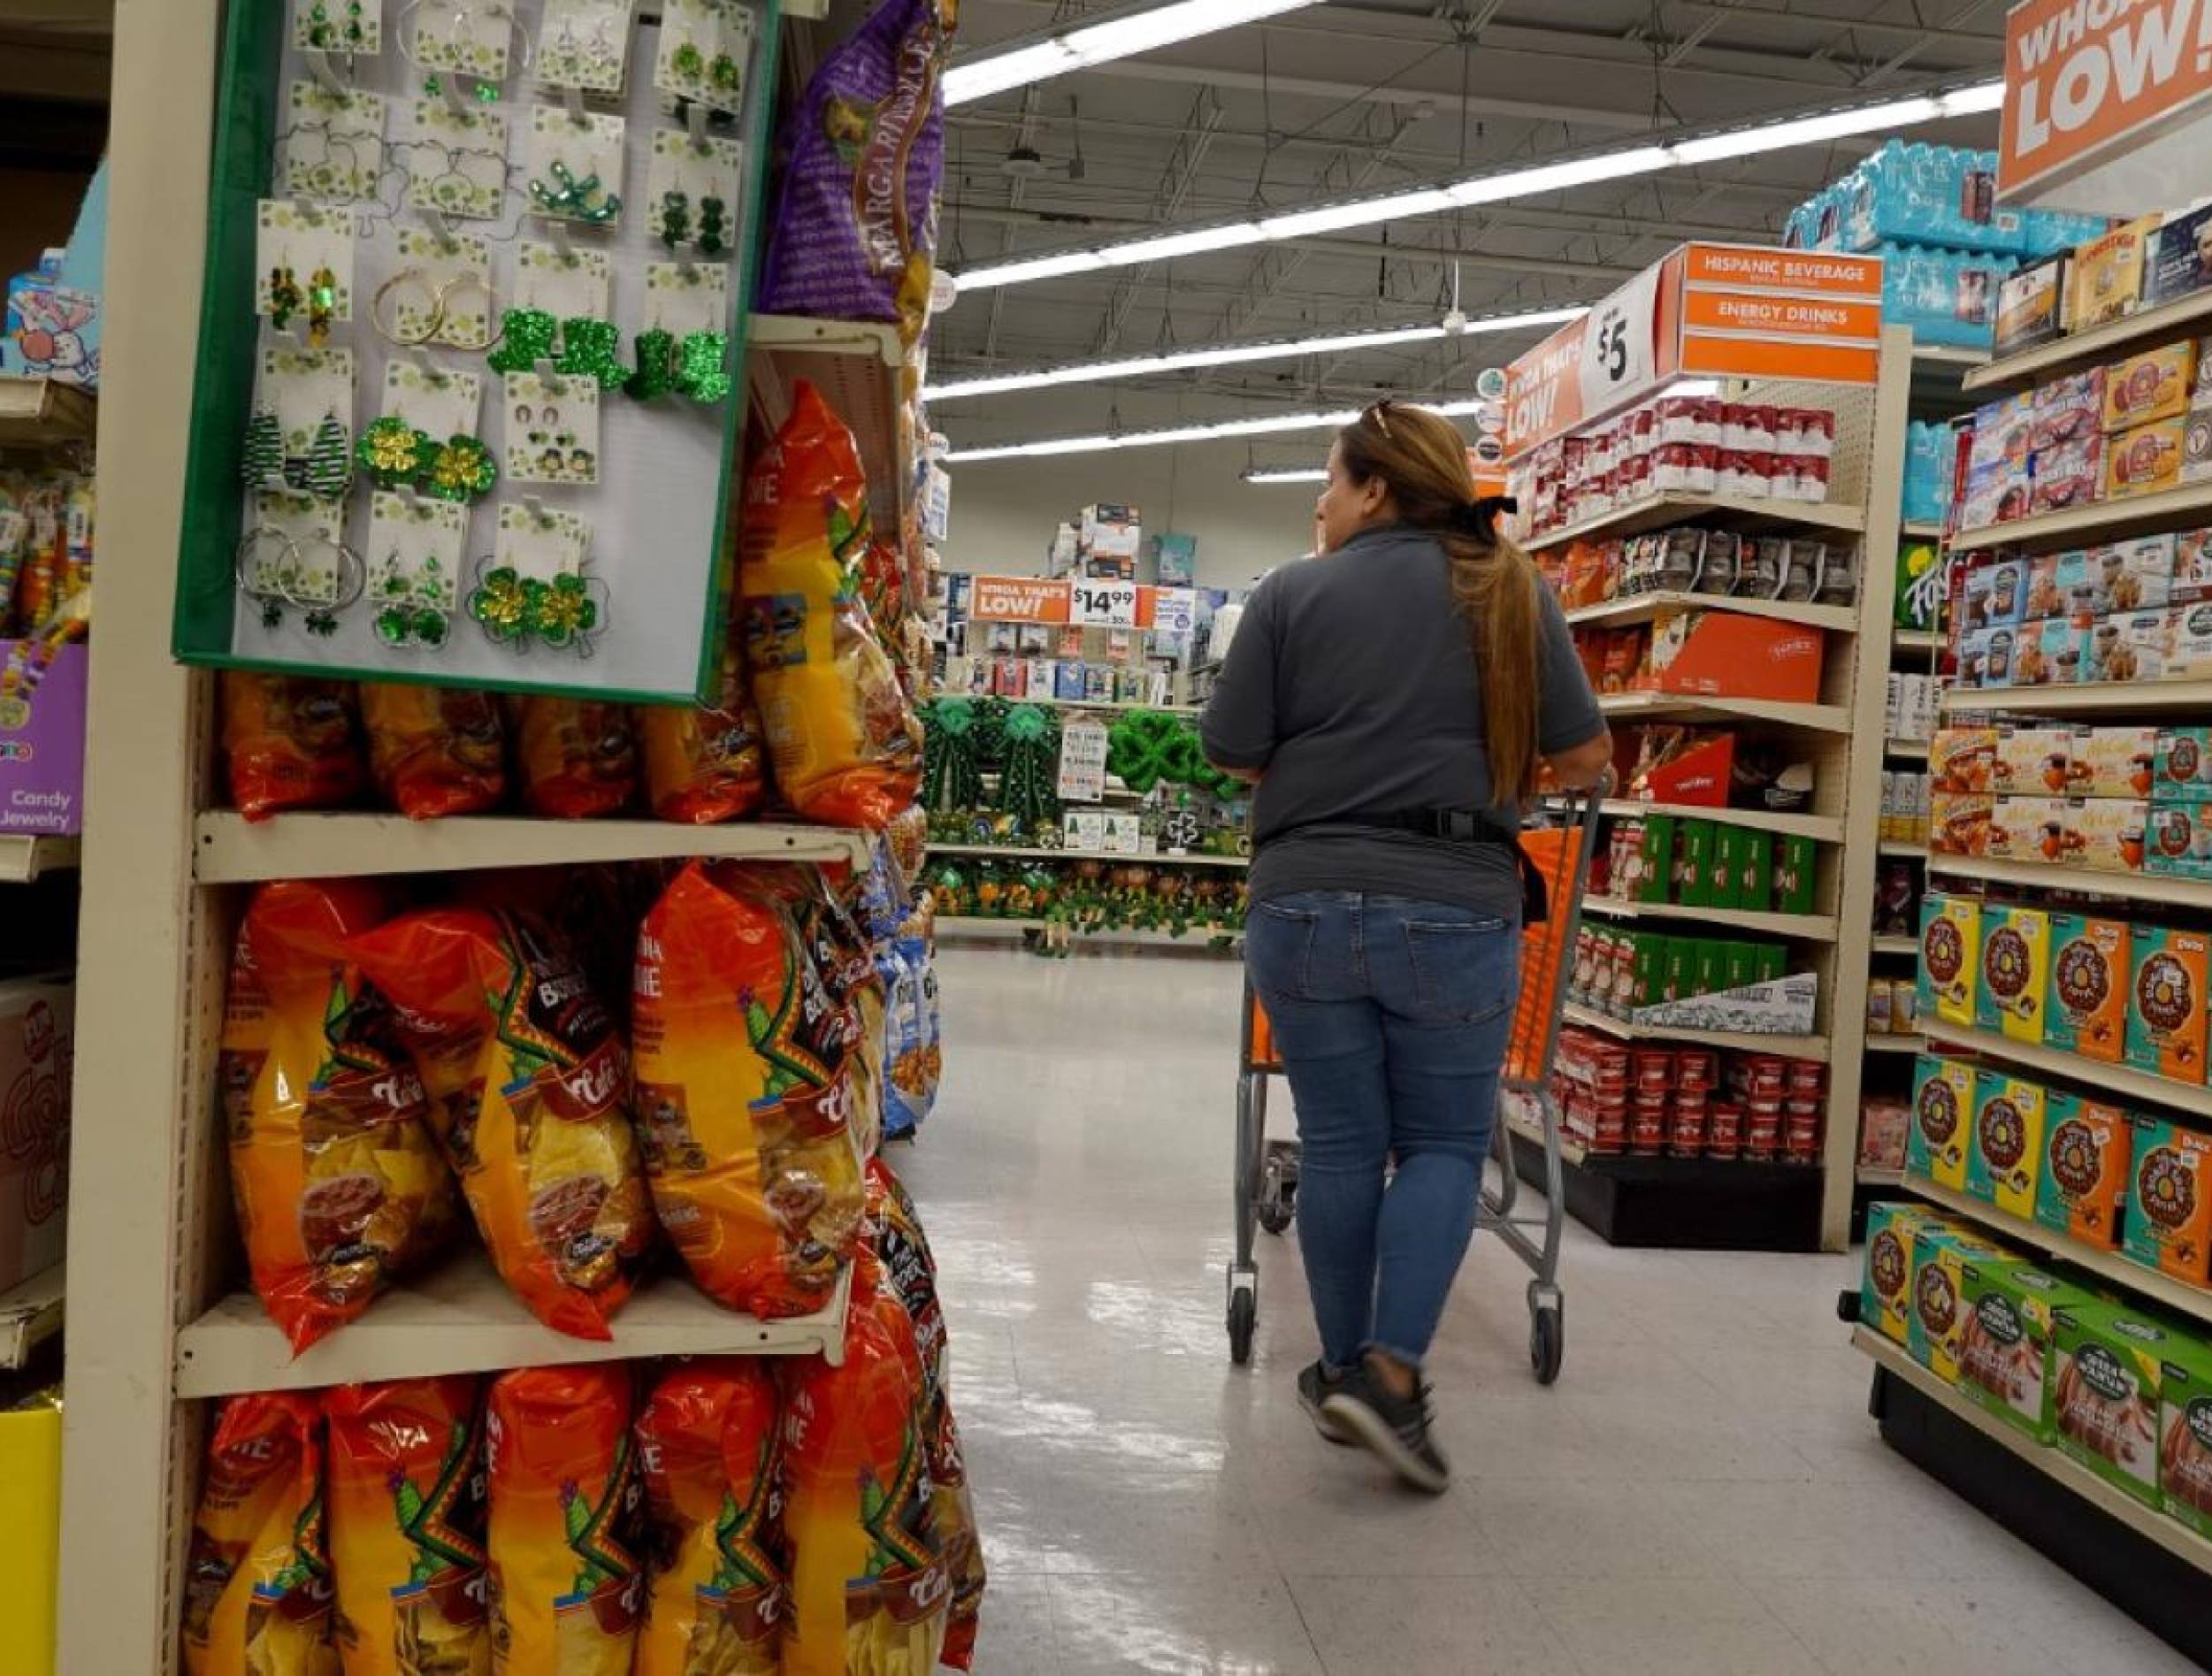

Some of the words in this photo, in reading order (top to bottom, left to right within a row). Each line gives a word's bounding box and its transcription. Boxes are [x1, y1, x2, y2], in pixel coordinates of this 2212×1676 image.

[2018, 0, 2132, 73] WHO
[2016, 0, 2212, 158] LOW!
[1705, 255, 1780, 273] HISPANIC
[1784, 262, 1865, 281] BEVERAGE
[1718, 301, 1783, 319] ENERGY
[1786, 306, 1848, 325] DRINKS
[980, 595, 1042, 617] LOW!
[11, 789, 72, 812] Candy
[0, 809, 70, 832] Jewelry
